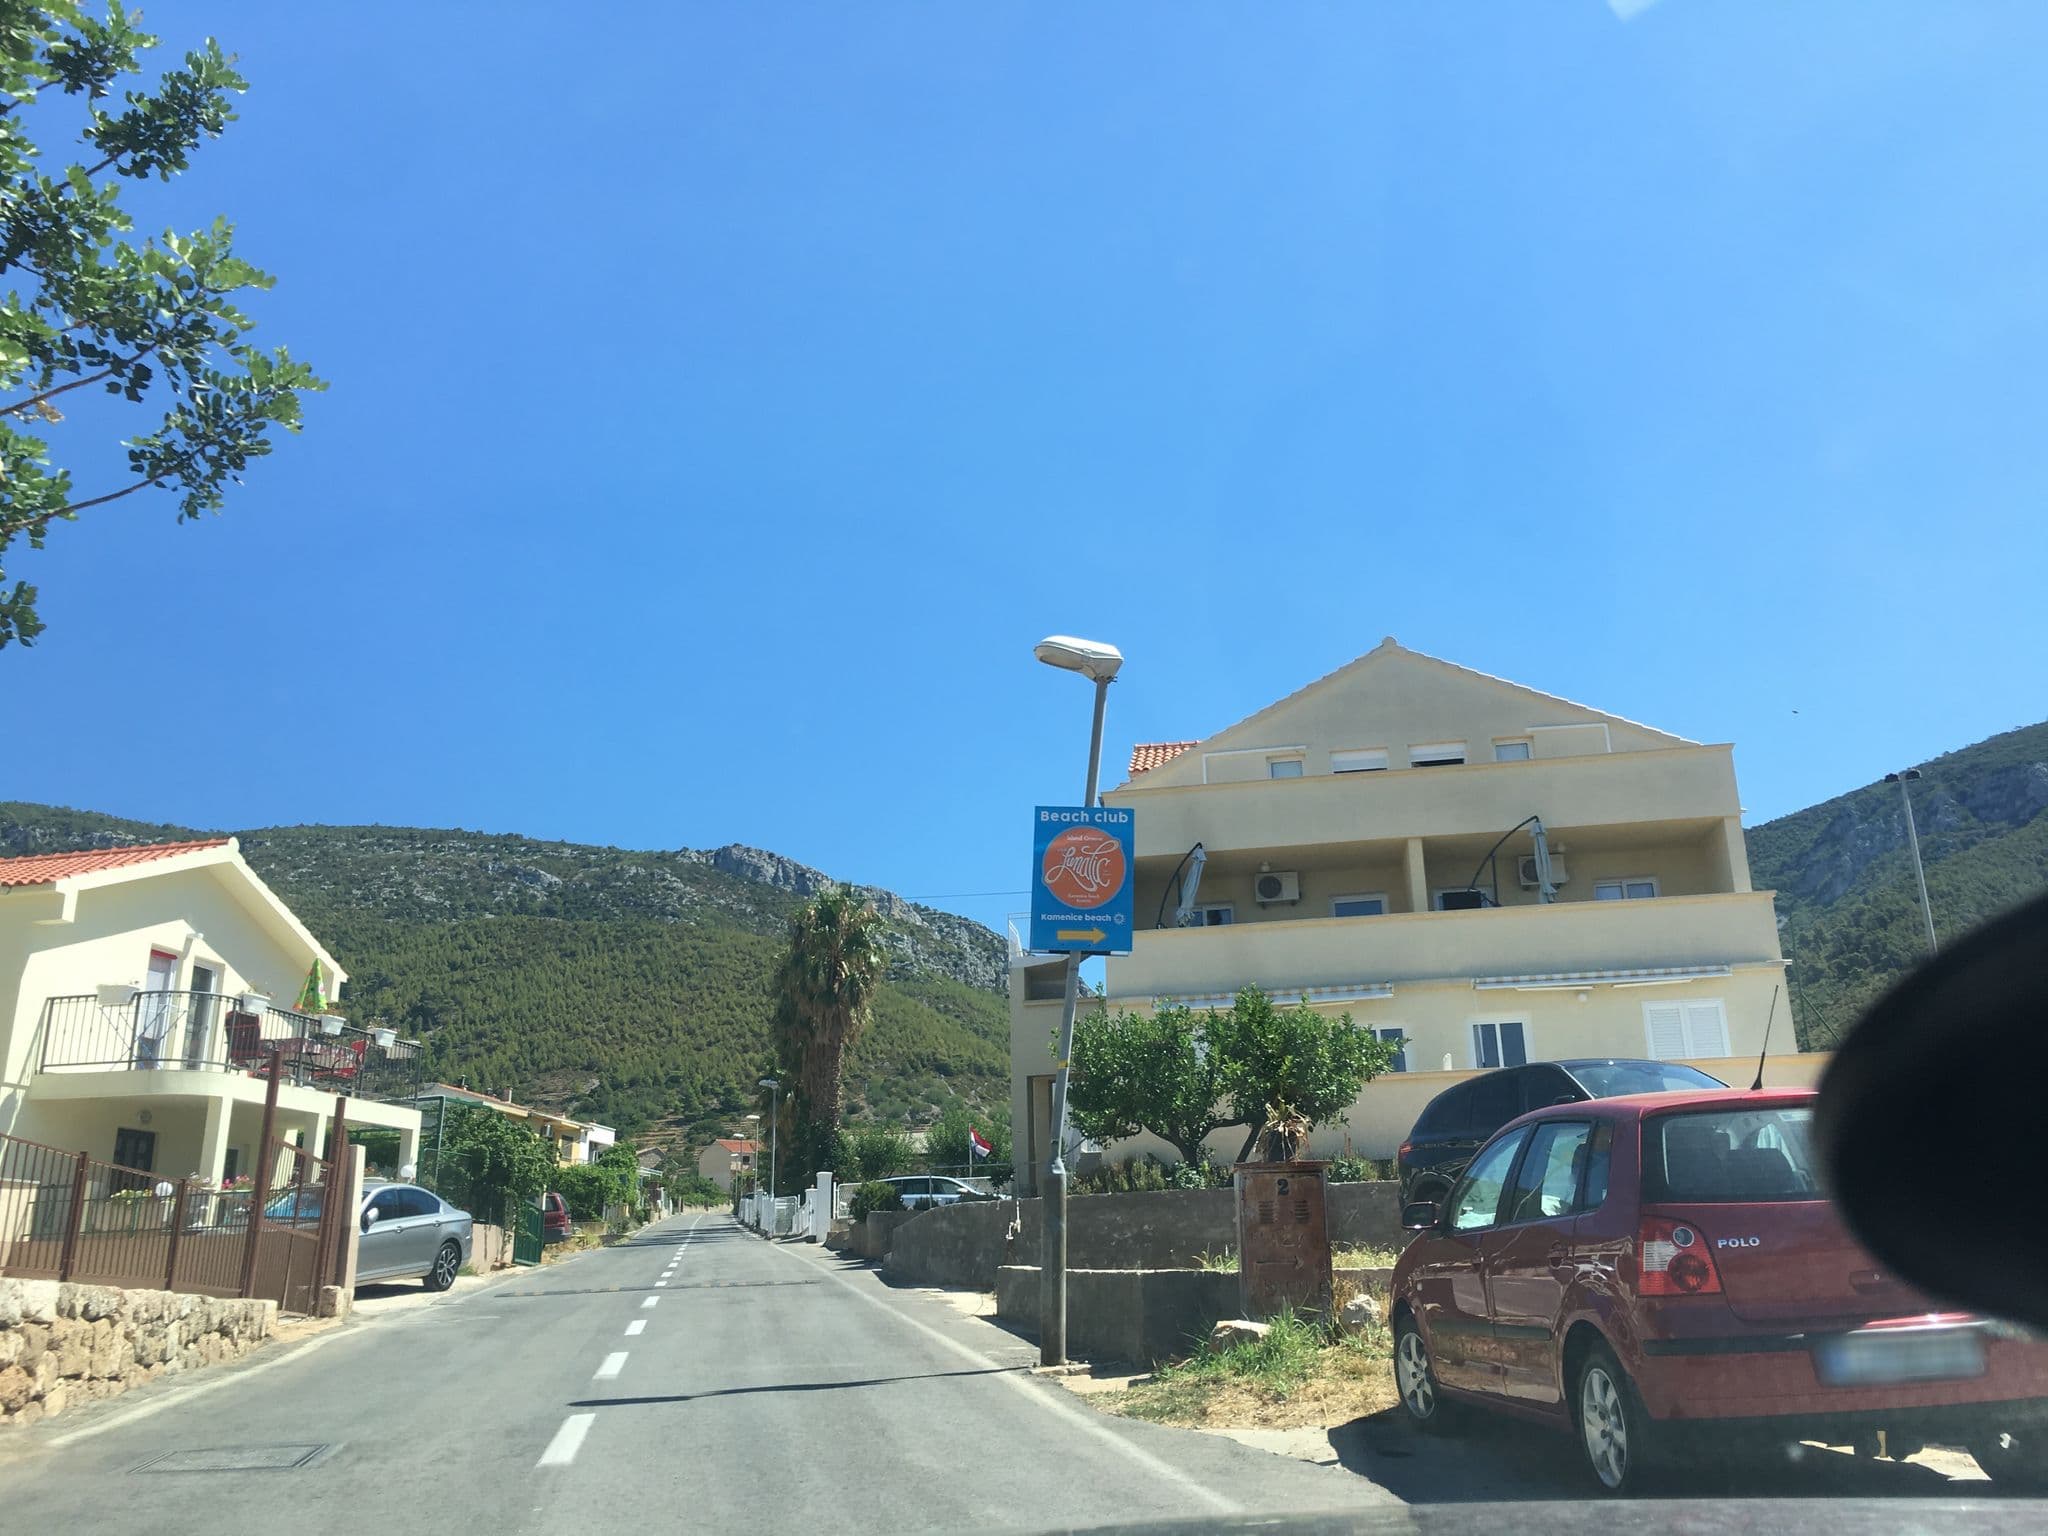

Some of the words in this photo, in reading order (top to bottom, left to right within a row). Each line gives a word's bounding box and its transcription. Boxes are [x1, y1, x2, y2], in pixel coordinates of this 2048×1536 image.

[1040, 811, 1089, 822] Beach
[1094, 811, 1129, 823] club
[1041, 912, 1083, 921] Kamenice
[1084, 913, 1112, 922] beach
[1277, 1178, 1289, 1196] 2
[1717, 1236, 1760, 1249] POLO
